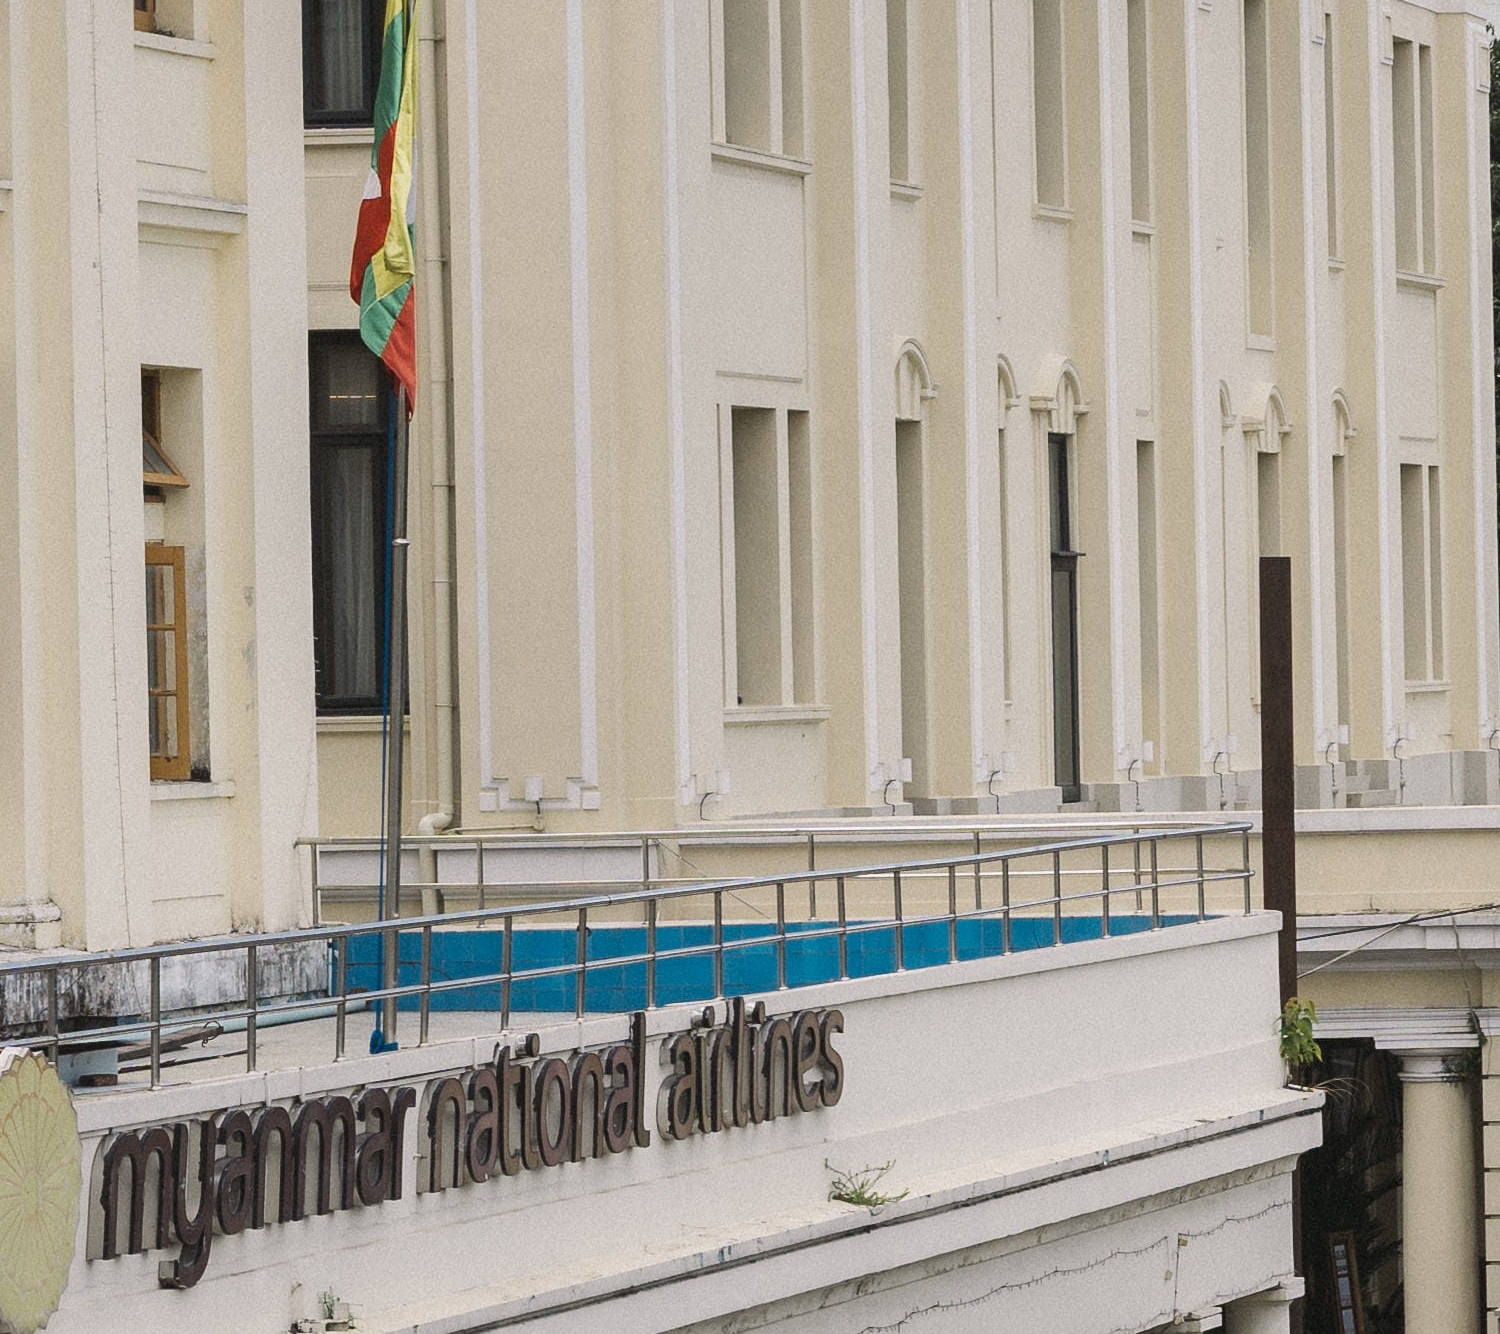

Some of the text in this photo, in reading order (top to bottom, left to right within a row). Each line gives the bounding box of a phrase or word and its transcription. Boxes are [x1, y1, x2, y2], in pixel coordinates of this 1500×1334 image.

[95, 996, 846, 1288] myanmar national airlines
